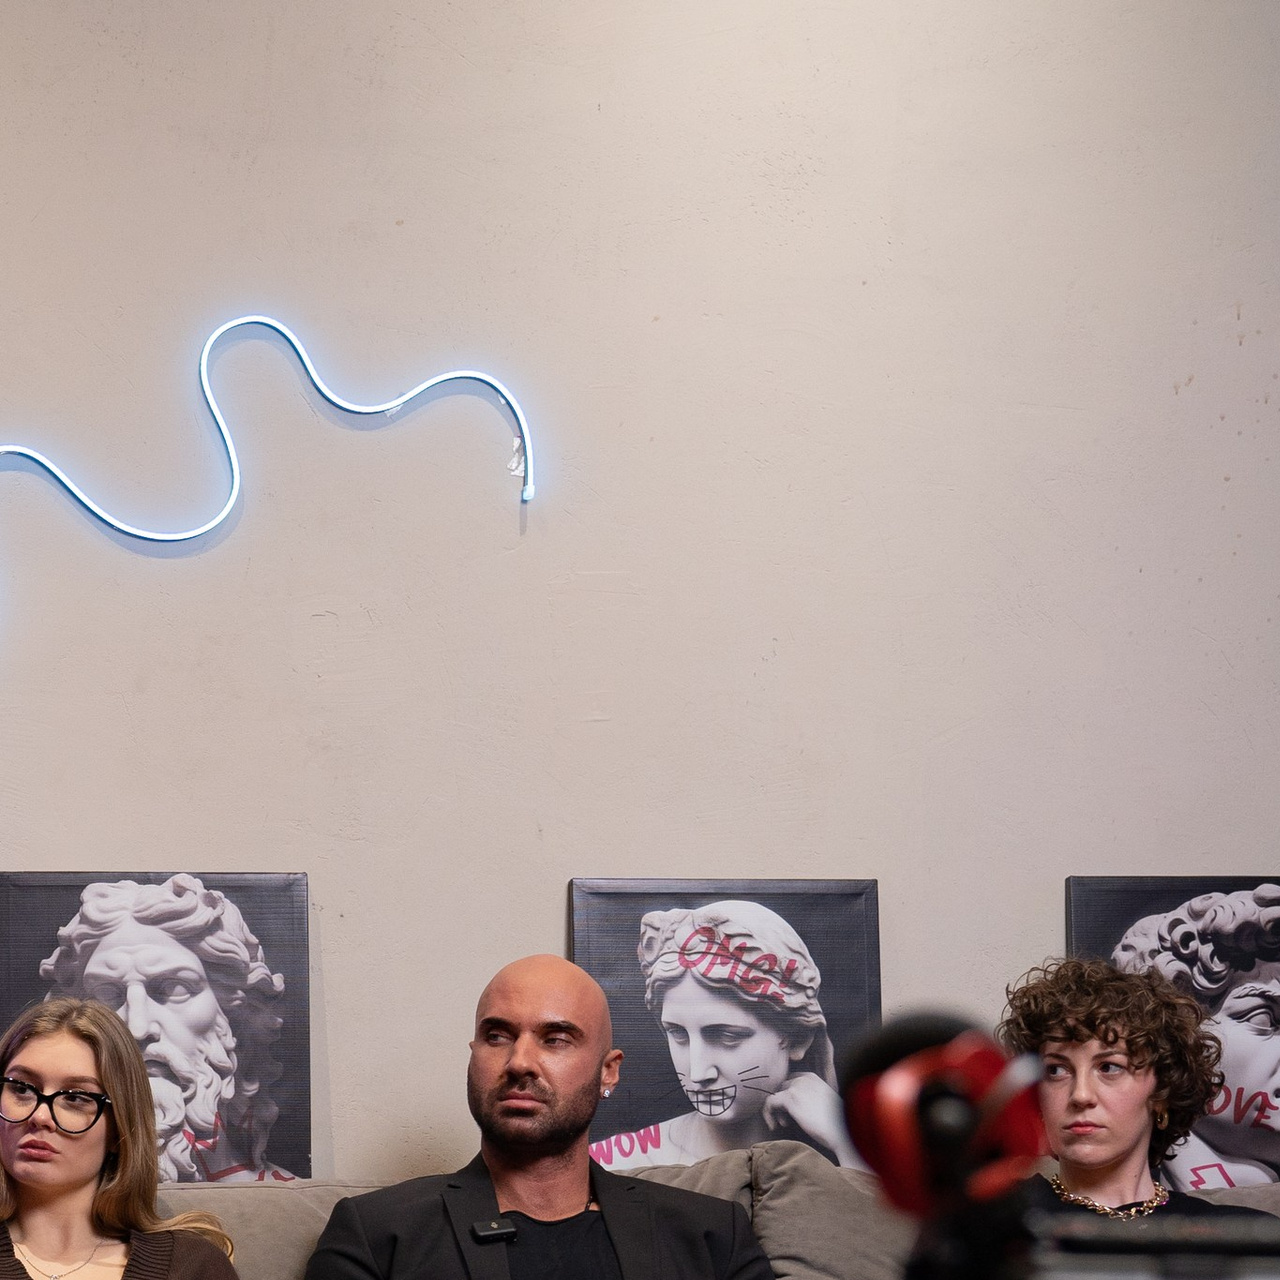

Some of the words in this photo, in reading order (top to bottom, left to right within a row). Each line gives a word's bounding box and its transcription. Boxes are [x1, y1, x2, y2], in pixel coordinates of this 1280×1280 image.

[678, 926, 797, 1004] OMG!
[1206, 1084, 1279, 1132] OVE
[588, 1124, 661, 1165] WOW
